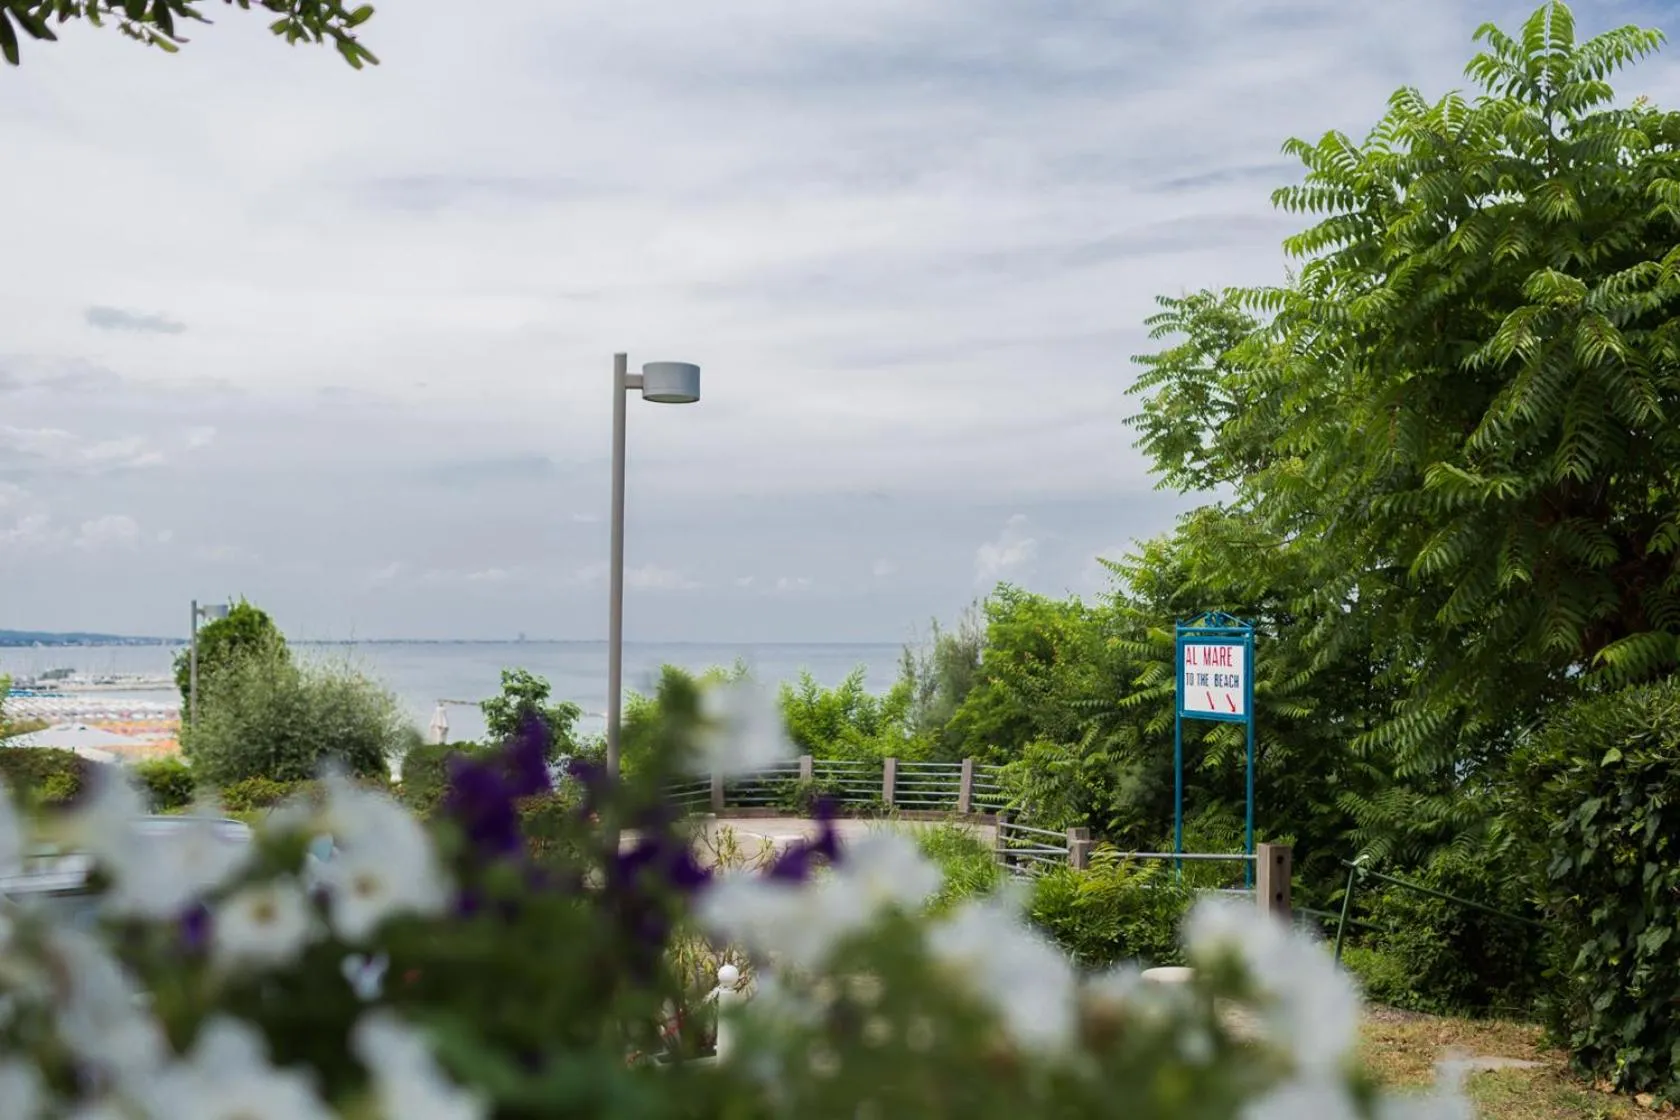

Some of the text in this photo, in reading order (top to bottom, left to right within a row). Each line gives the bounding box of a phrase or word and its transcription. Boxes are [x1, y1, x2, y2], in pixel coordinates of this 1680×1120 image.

[1186, 646, 1233, 667] AL MARE
[1186, 672, 1240, 688] TO THE BEACH
